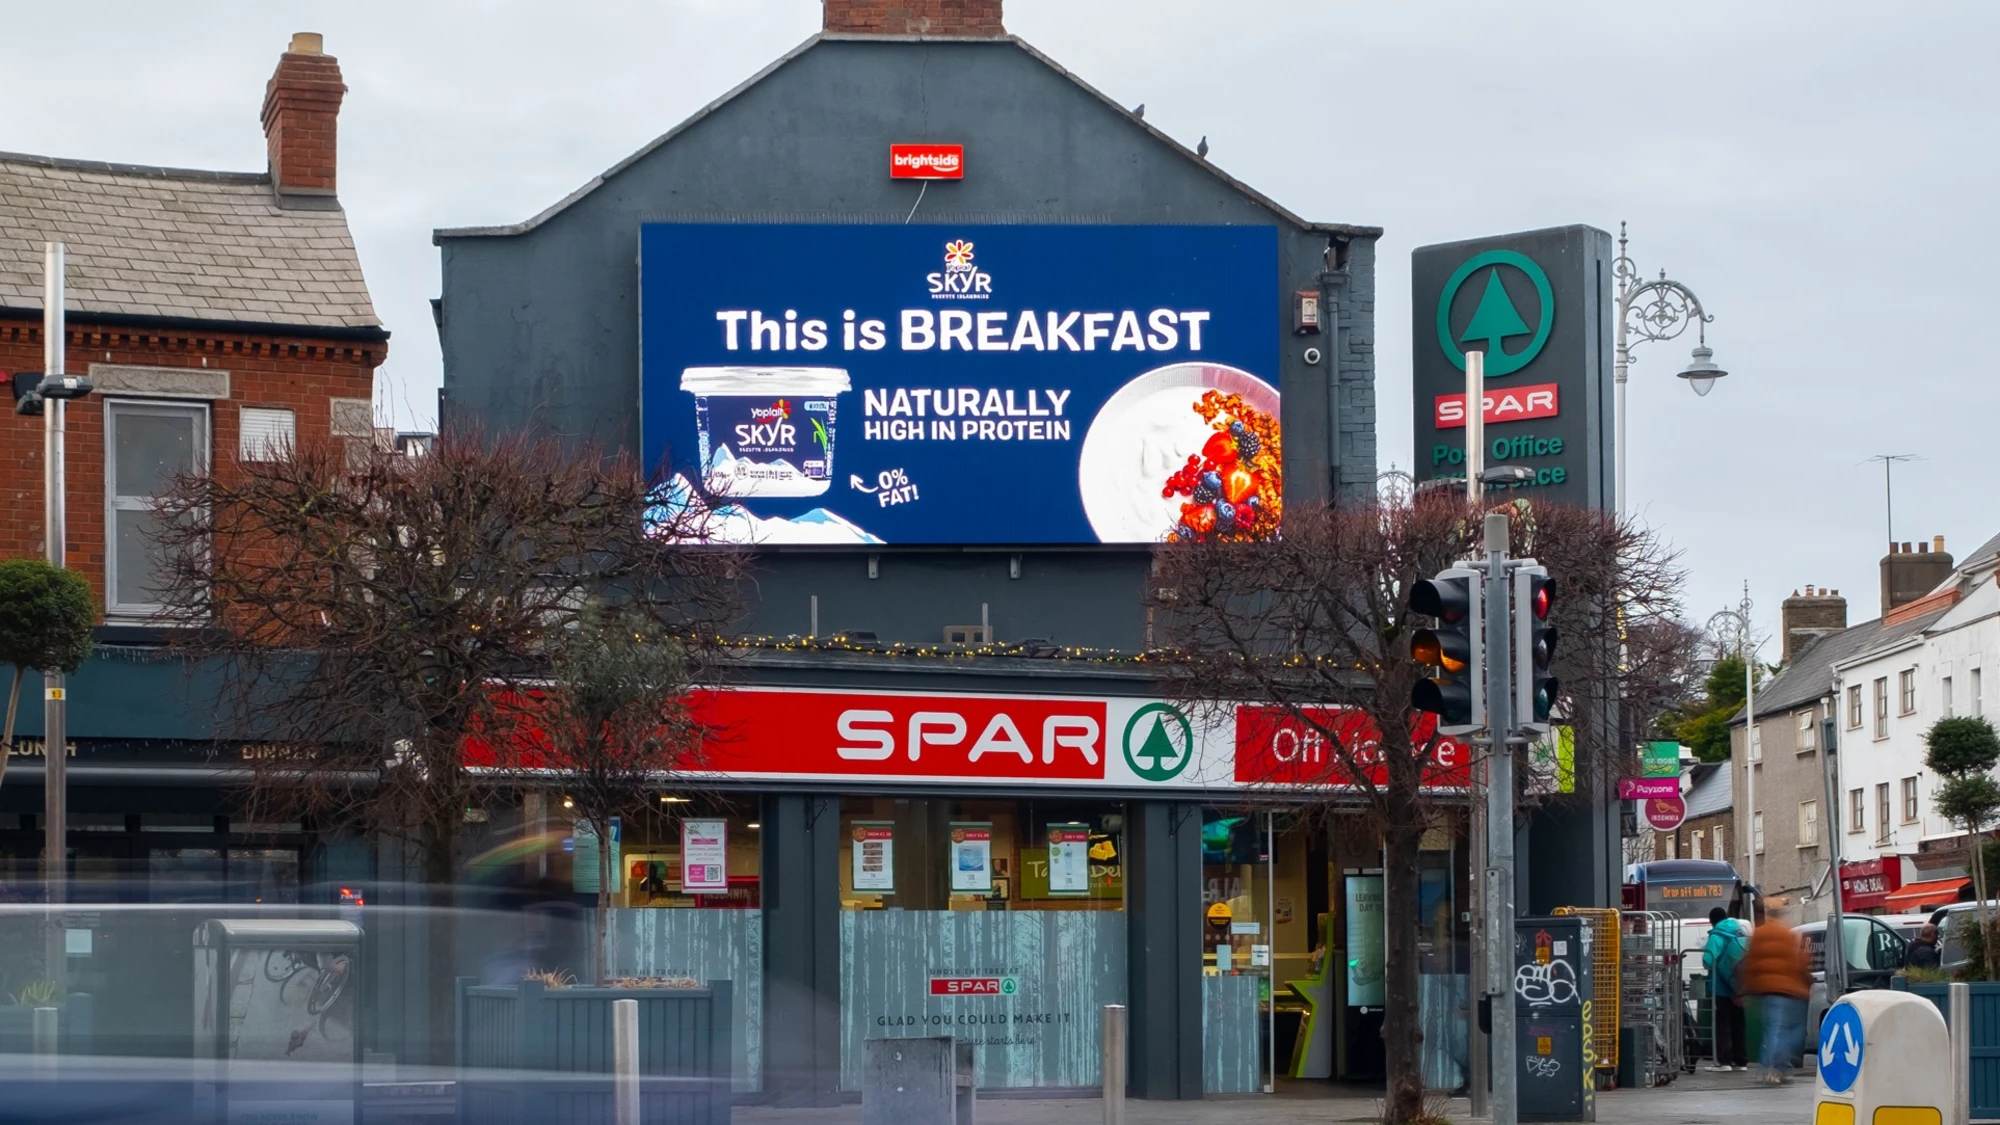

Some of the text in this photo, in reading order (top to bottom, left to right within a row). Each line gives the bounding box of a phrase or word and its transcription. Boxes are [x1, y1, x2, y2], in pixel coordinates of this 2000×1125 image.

[894, 153, 960, 170] brightside
[926, 265, 993, 294] SKYR
[717, 309, 1210, 352] This is BREAKFAST
[864, 388, 1071, 417] NATURALLY
[1438, 390, 1554, 422] SPAR
[735, 417, 797, 447] SKYR
[864, 420, 1071, 441] HIGH IN PROTEIN
[1432, 435, 1563, 466] Po Office
[878, 468, 909, 491] 0%
[878, 485, 920, 508] FAT!
[836, 708, 1100, 765] SPAR
[1272, 727, 1324, 763] Off
[9, 741, 77, 757] LUNH
[1636, 784, 1674, 794] Payzone
[1651, 814, 1680, 822] INSOMNIA
[1680, 886, 1692, 897] off
[929, 968, 960, 976] UNDER
[947, 980, 999, 992] SPAR
[877, 1012, 1070, 1026] GLAD YOU COULD MAKE IT
